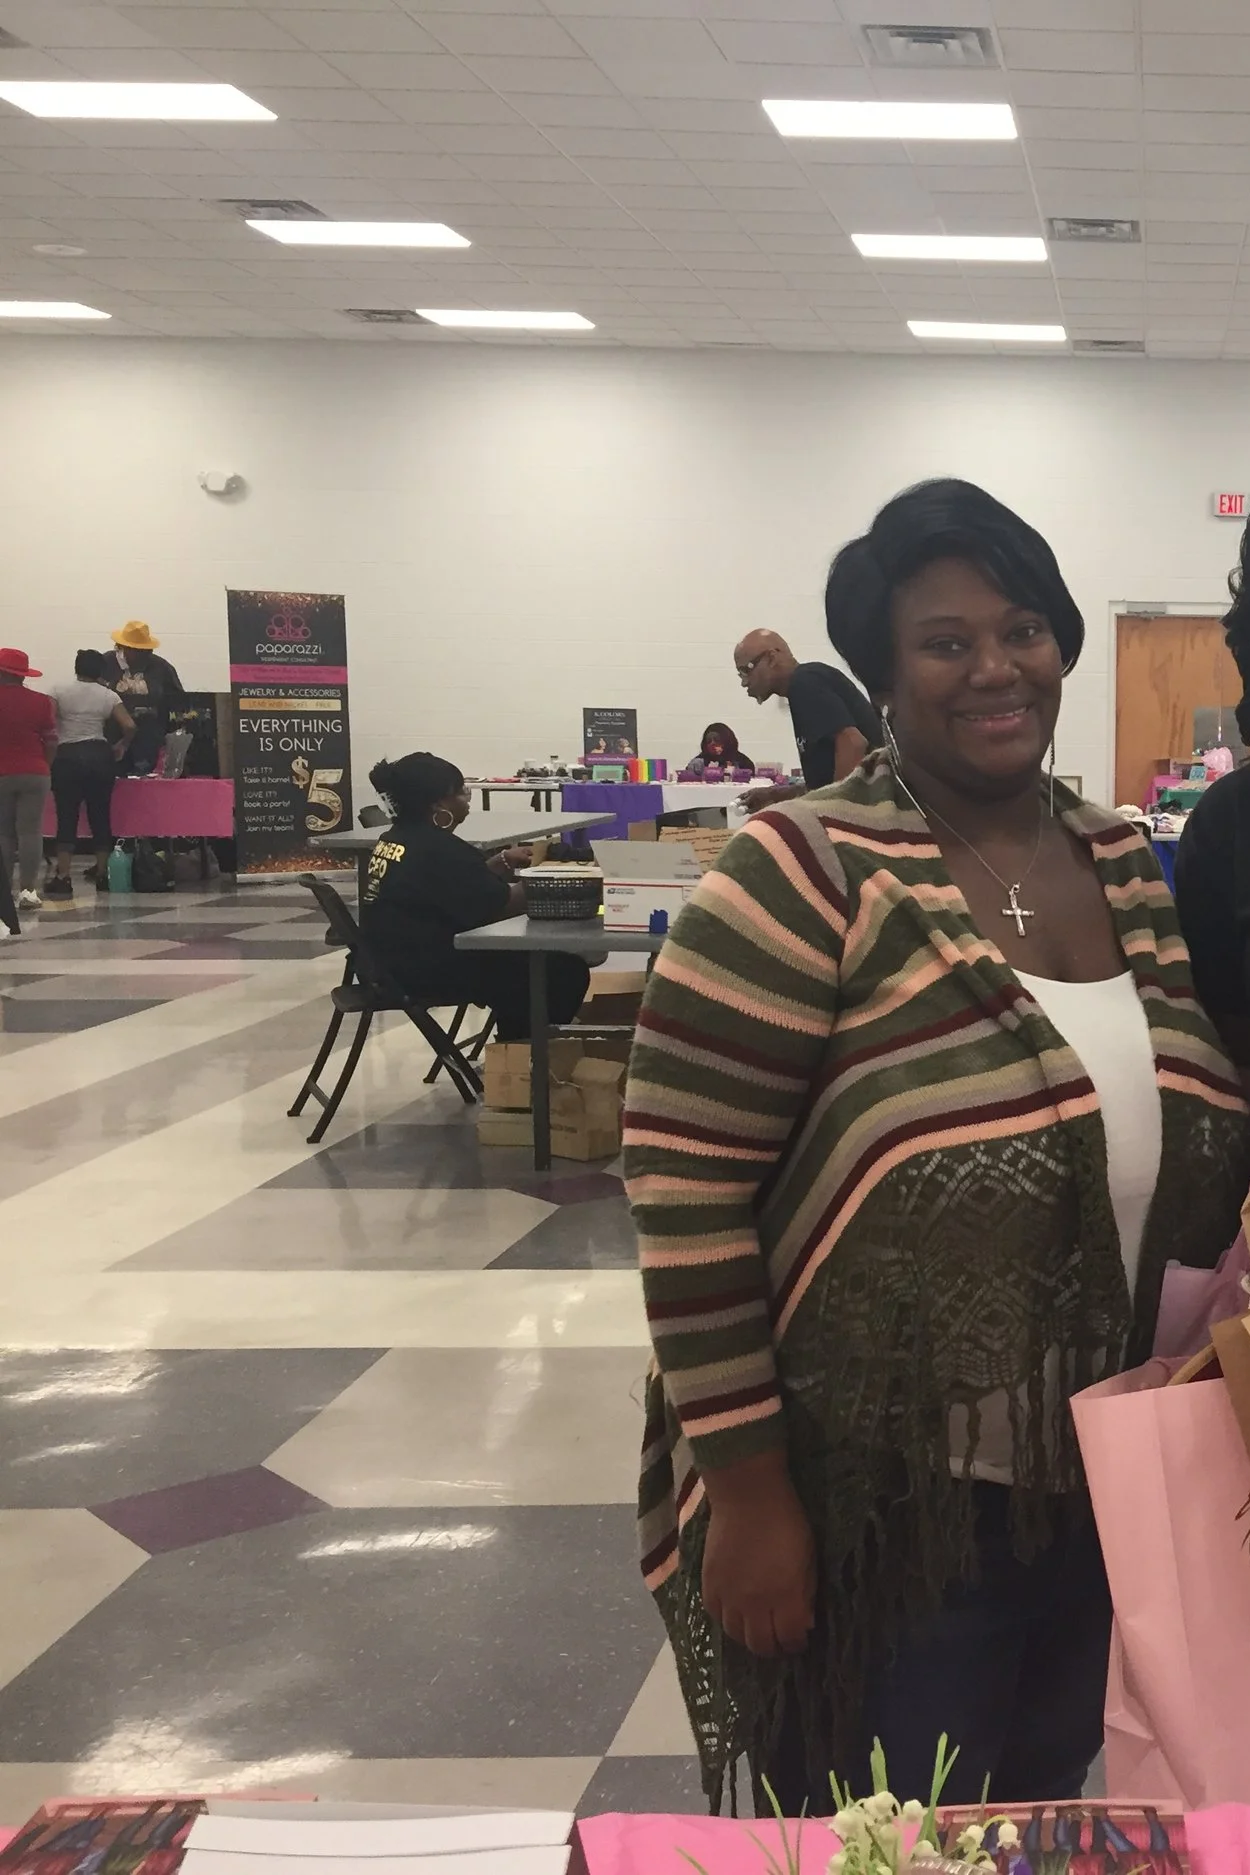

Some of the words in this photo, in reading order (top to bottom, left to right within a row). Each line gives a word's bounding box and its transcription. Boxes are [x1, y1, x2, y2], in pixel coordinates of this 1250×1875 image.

[1219, 494, 1245, 514] EXIT
[256, 643, 322, 656] paparazzi
[239, 687, 276, 697] JEWELRY
[278, 688, 285, 697] &
[287, 688, 341, 698] ACCESSORIES
[240, 718, 343, 733] EVERYTHING
[259, 738, 274, 751] IS
[279, 738, 324, 751] ONLY
[243, 790, 263, 799] LOVE
[243, 800, 261, 808] Book
[244, 815, 266, 823] WANT
